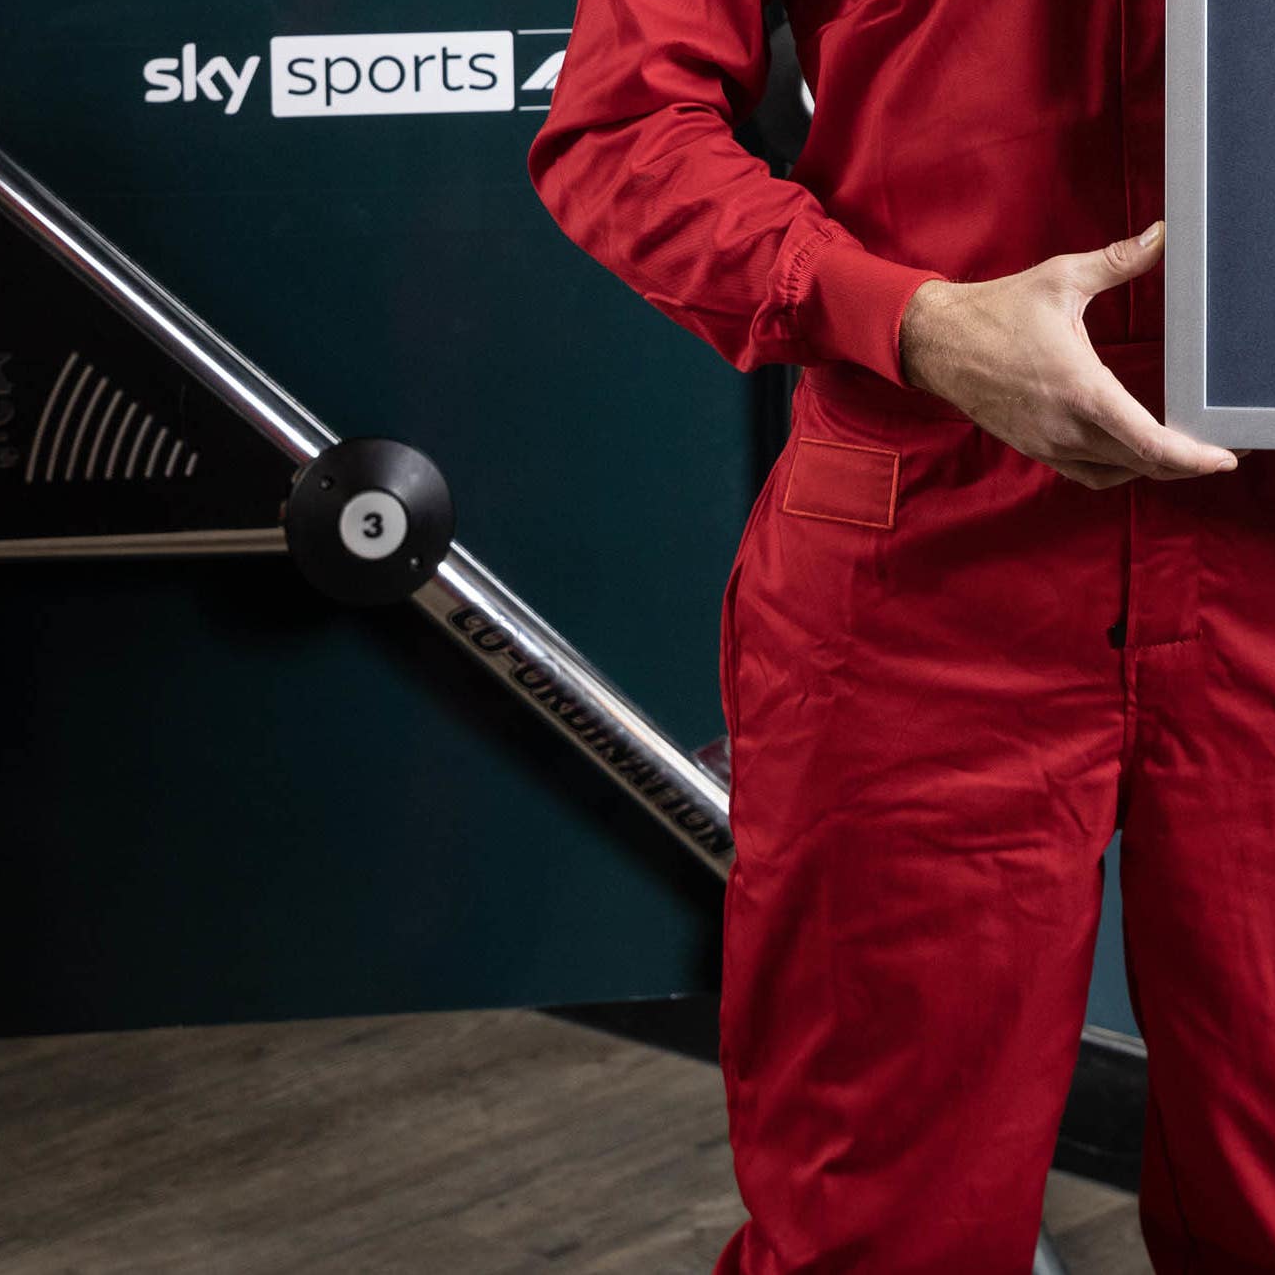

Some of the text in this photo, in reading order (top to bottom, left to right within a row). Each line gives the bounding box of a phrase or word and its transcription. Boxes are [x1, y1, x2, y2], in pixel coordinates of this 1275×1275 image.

[143, 41, 261, 116] sky
[286, 45, 499, 106] sports
[362, 512, 385, 539] 3
